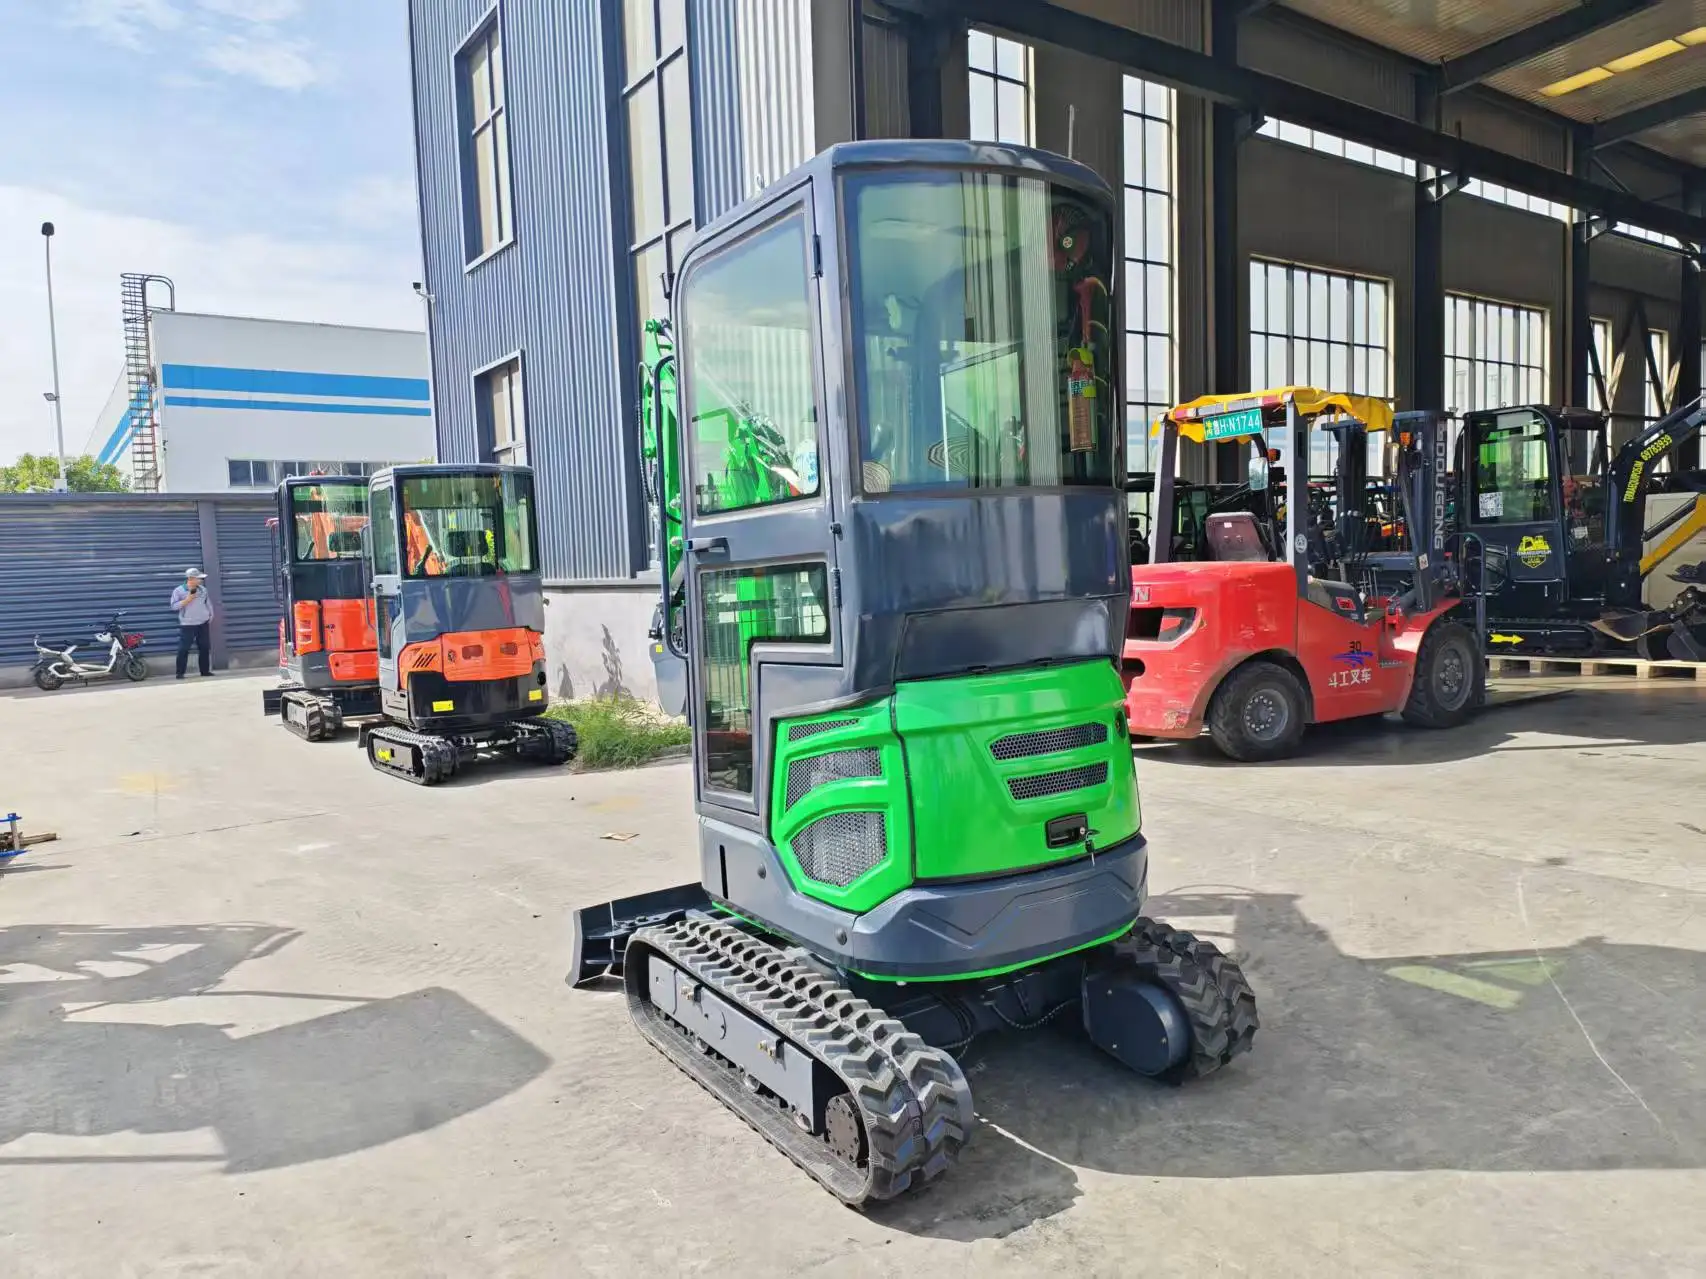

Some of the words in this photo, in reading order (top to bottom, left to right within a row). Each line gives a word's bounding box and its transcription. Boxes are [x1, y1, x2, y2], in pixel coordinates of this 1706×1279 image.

[1640, 434, 1673, 461] 69783939
[1328, 668, 1372, 688] 斗工叉车
